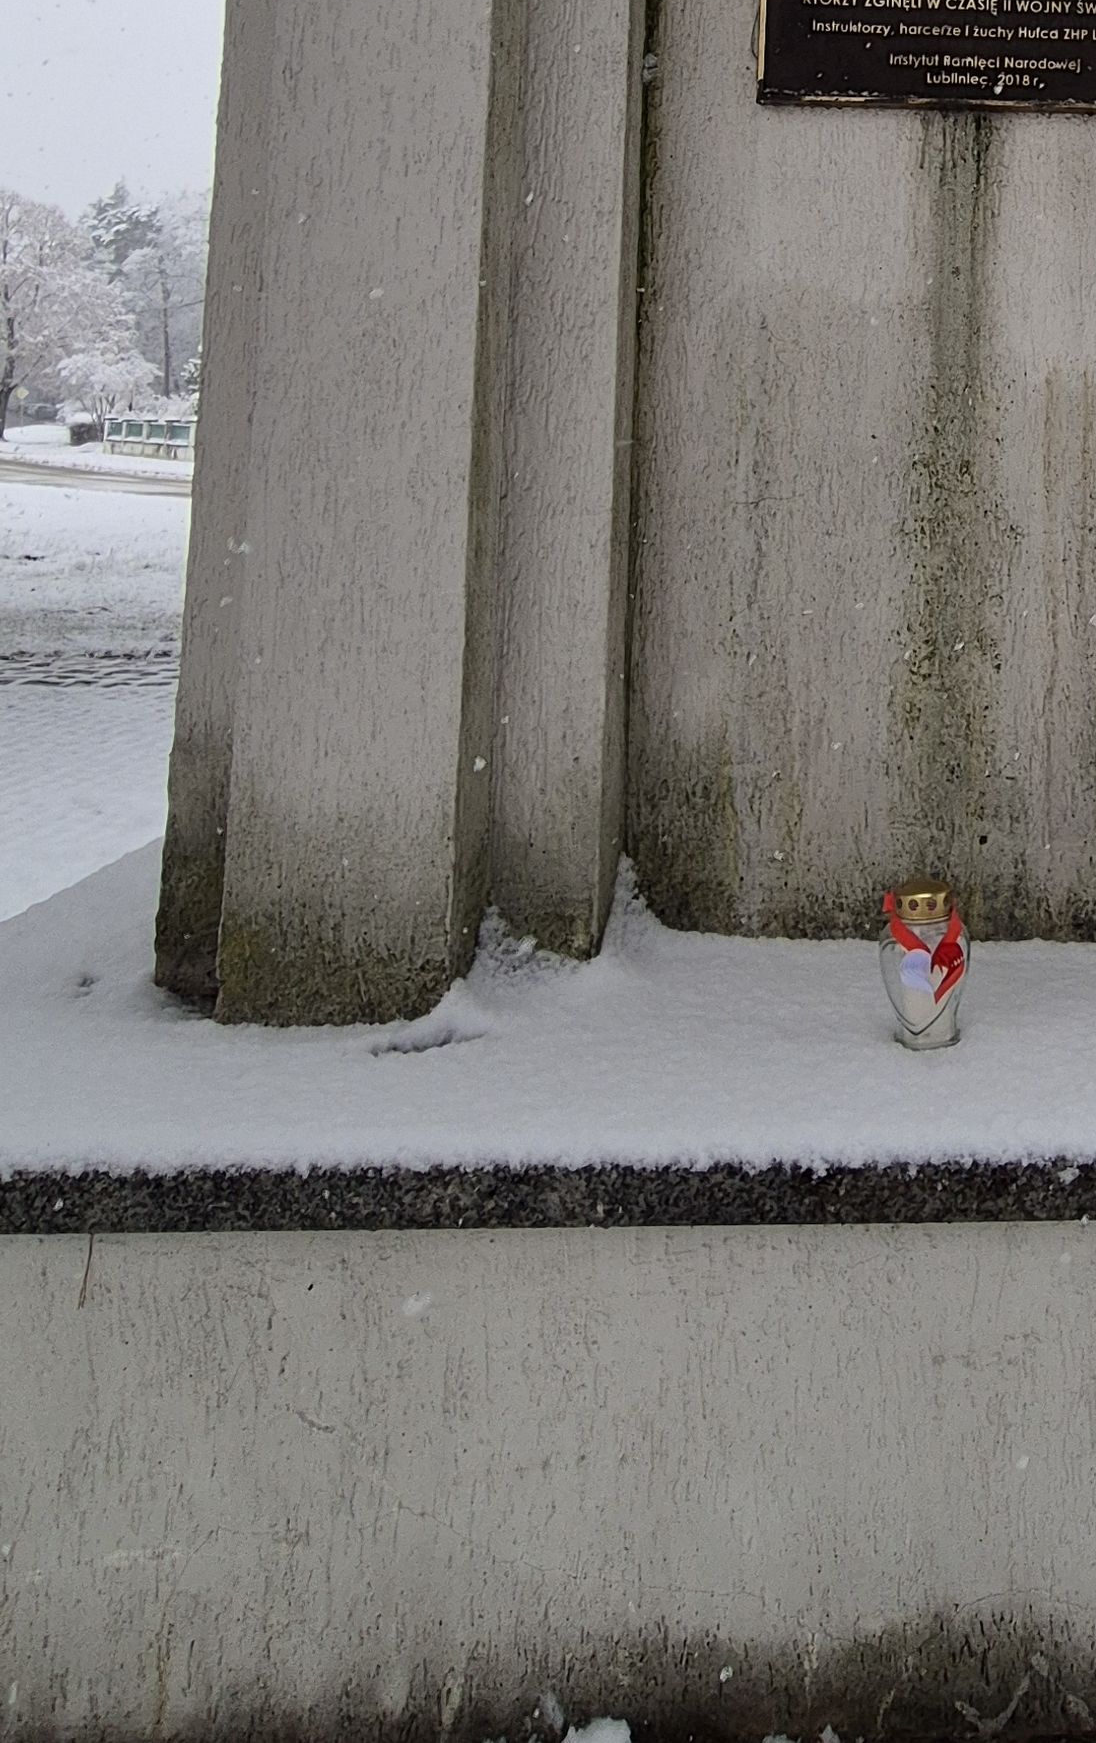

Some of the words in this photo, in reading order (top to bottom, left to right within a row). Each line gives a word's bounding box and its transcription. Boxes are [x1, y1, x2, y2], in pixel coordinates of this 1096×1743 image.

[1003, 0, 1012, 12] II
[1015, 0, 1072, 14] WOJNY
[812, 19, 895, 37] Instruktorzy,
[899, 23, 961, 36] harcerze
[1018, 27, 1058, 39] Hufca
[1063, 29, 1088, 40] ZHP
[889, 54, 939, 69] Instytut
[1004, 57, 1082, 73] Narodowej
[997, 74, 1030, 86] 2018
